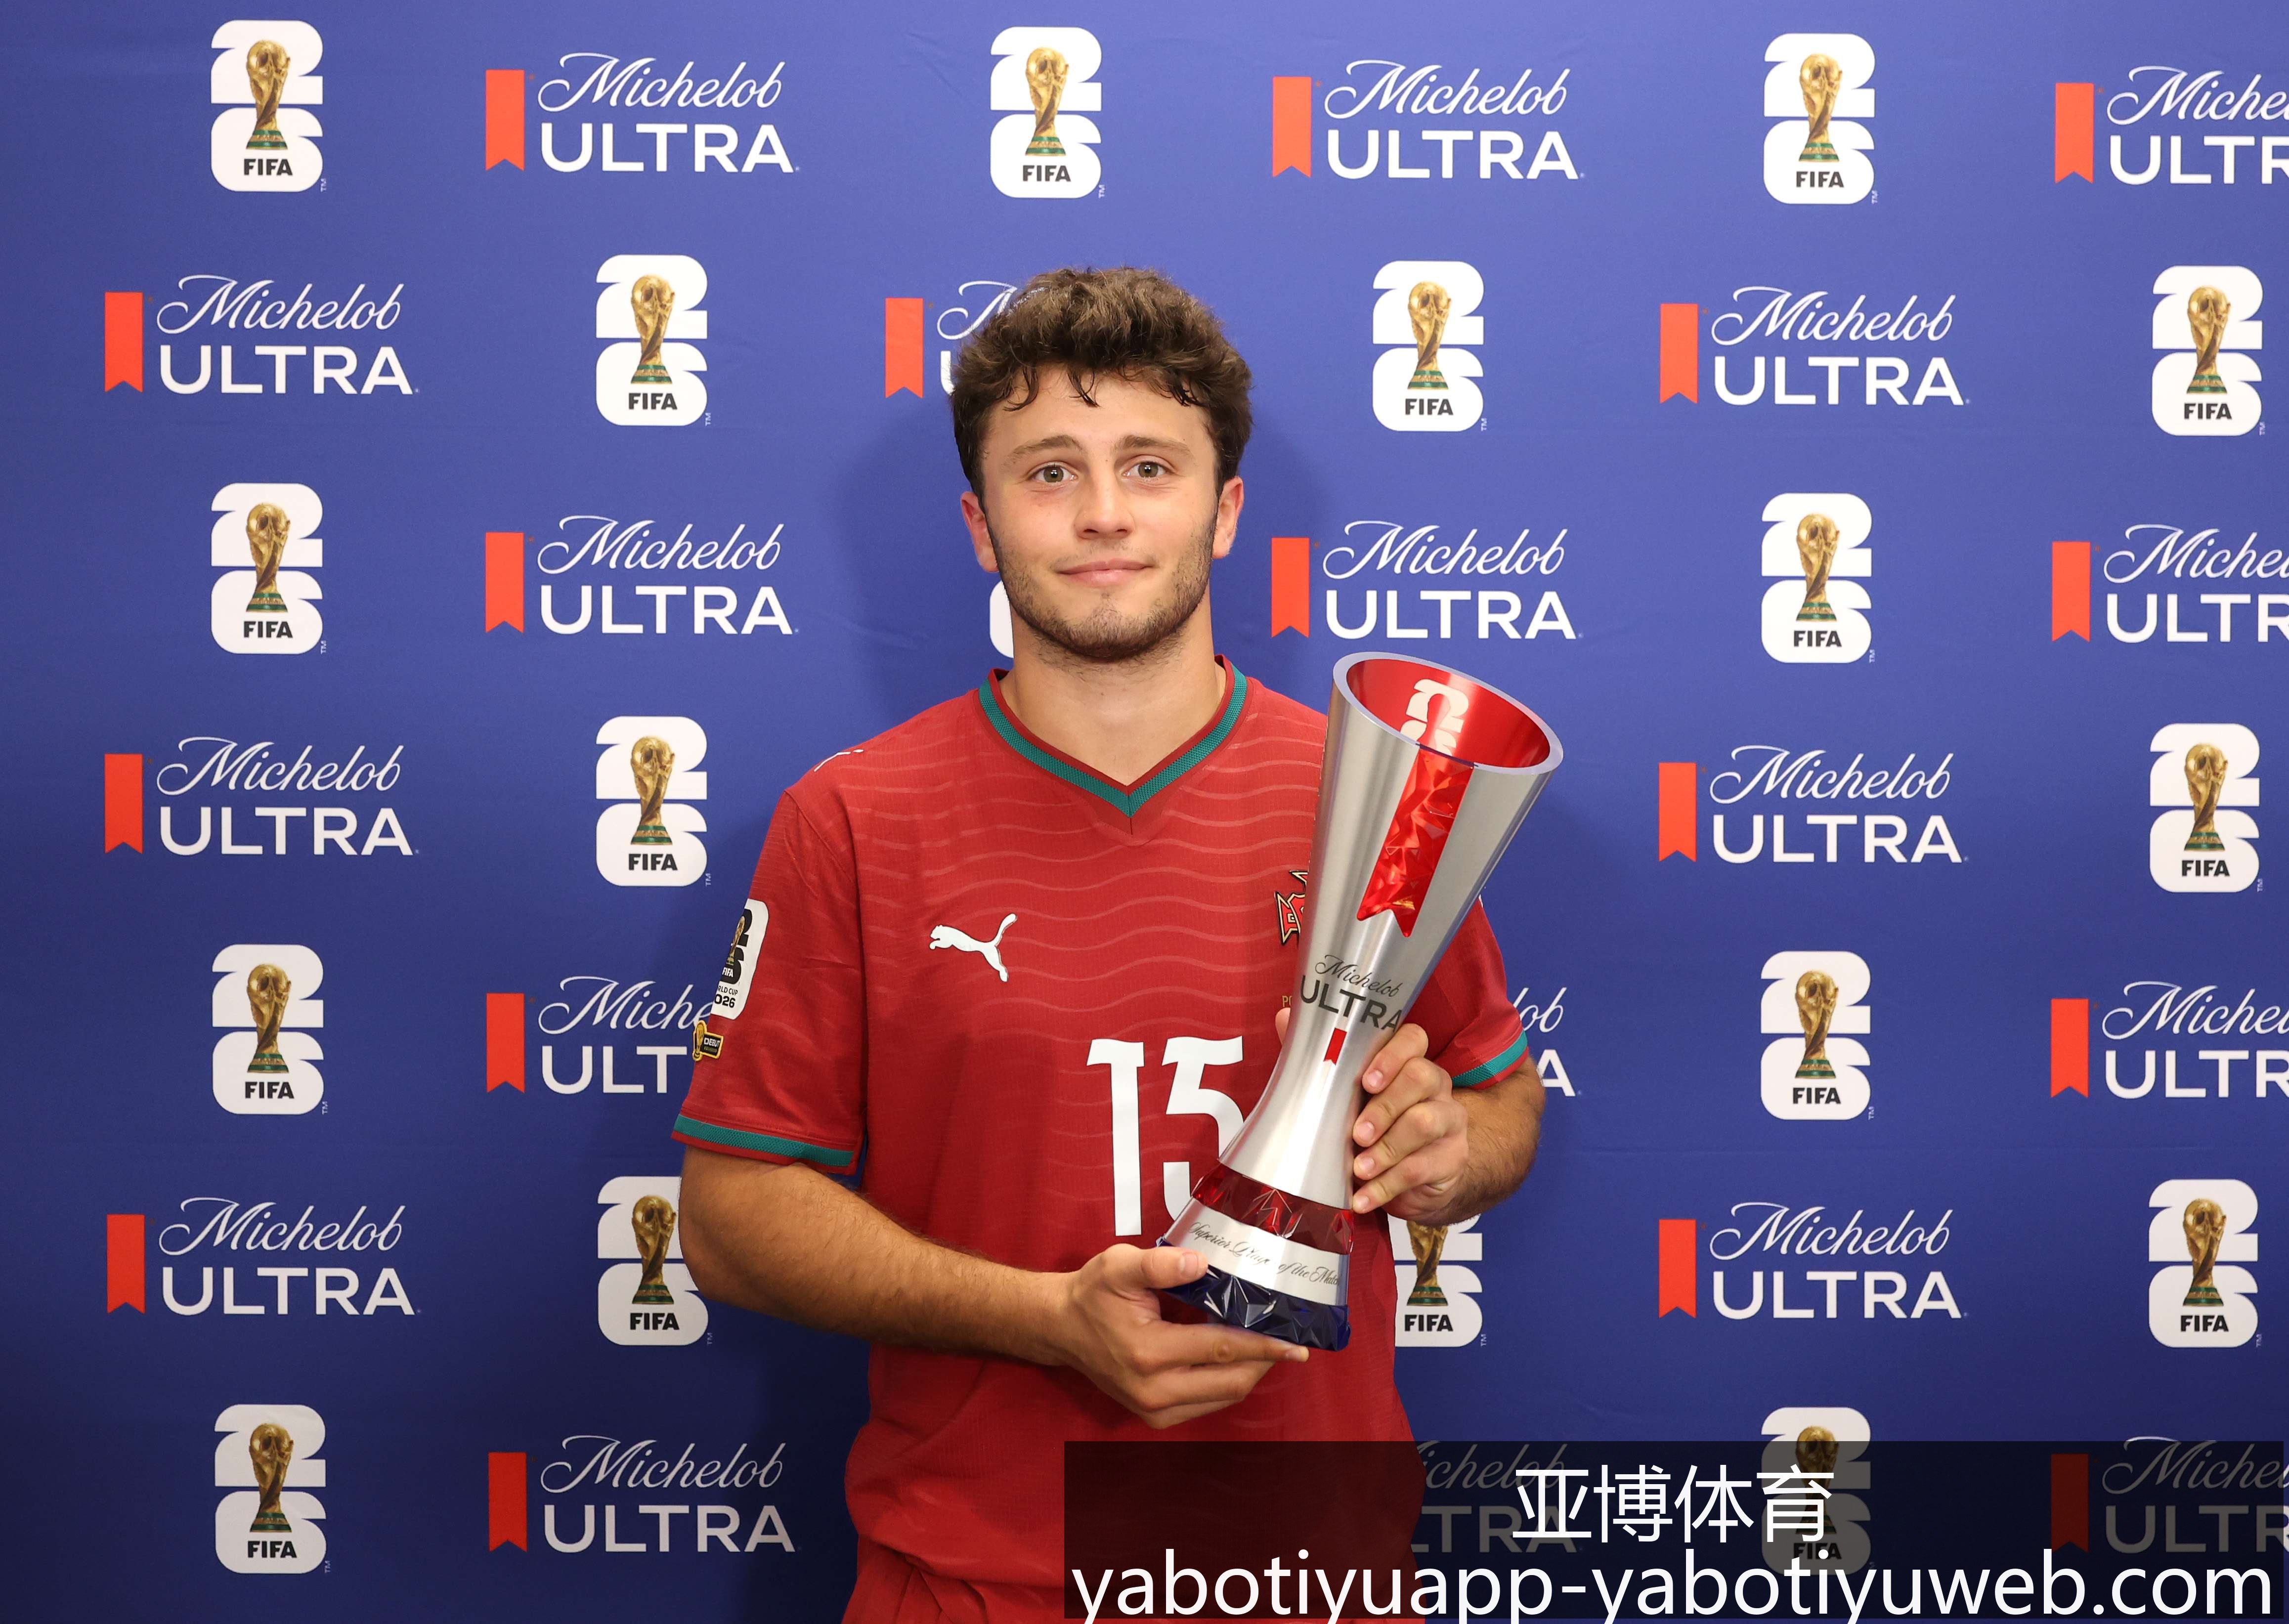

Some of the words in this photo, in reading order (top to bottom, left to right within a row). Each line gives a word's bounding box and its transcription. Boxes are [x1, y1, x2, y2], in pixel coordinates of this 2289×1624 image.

[538, 52, 785, 112] Michelob
[1325, 59, 1571, 119] Michelob
[245, 159, 292, 175] FIFA
[541, 123, 793, 173] ULTRA
[1328, 129, 1579, 180] ULTRA
[1023, 166, 1071, 181] FIFA
[1796, 171, 1844, 187] FIFA
[157, 275, 404, 334] Michelob
[1711, 286, 1956, 346] Michelob
[161, 345, 413, 394] ULTRA
[1715, 356, 1964, 405] ULTRA
[629, 393, 677, 410] FIFA
[1405, 399, 1453, 415] FIFA
[2184, 403, 2232, 420] FIFA
[538, 515, 784, 574] Michelob
[1323, 520, 1568, 579] Michelob
[244, 621, 293, 638] FIFA
[541, 585, 793, 635] ULTRA
[1326, 590, 1576, 639] ULTRA
[1794, 631, 1842, 647] FIFA
[157, 737, 404, 795] Michelob
[1710, 745, 1954, 804] Michelob
[160, 807, 413, 855] ULTRA
[1713, 814, 1962, 863] ULTRA
[629, 854, 678, 870] FIFA
[2182, 860, 2230, 876] FIFA
[718, 985, 728, 993] RLD
[729, 987, 738, 996] CUP
[1315, 954, 1403, 998] Michelob
[714, 993, 736, 1008] 026
[1300, 975, 1403, 1033] ULTRA
[703, 1037, 720, 1047] DEBUT
[245, 1082, 294, 1099] FIFA
[542, 1046, 687, 1094] ULT
[1793, 1088, 1841, 1104] FIFA
[1087, 1035, 1244, 1236] 15
[159, 1197, 405, 1255] Michelob
[1189, 1222, 1231, 1249] Superior
[1276, 1262, 1302, 1274] of
[1291, 1265, 1310, 1278] the
[1710, 1202, 1953, 1260] Michelob
[163, 1267, 415, 1315] ULTRA
[1713, 1272, 1961, 1320] ULTRA
[630, 1313, 680, 1330] FIFA
[1405, 1315, 1453, 1332] FIFA
[2181, 1316, 2229, 1332] FIFA
[540, 1435, 786, 1493] Michelob
[248, 1541, 297, 1558] FIFA
[544, 1505, 796, 1552] ULTRA
